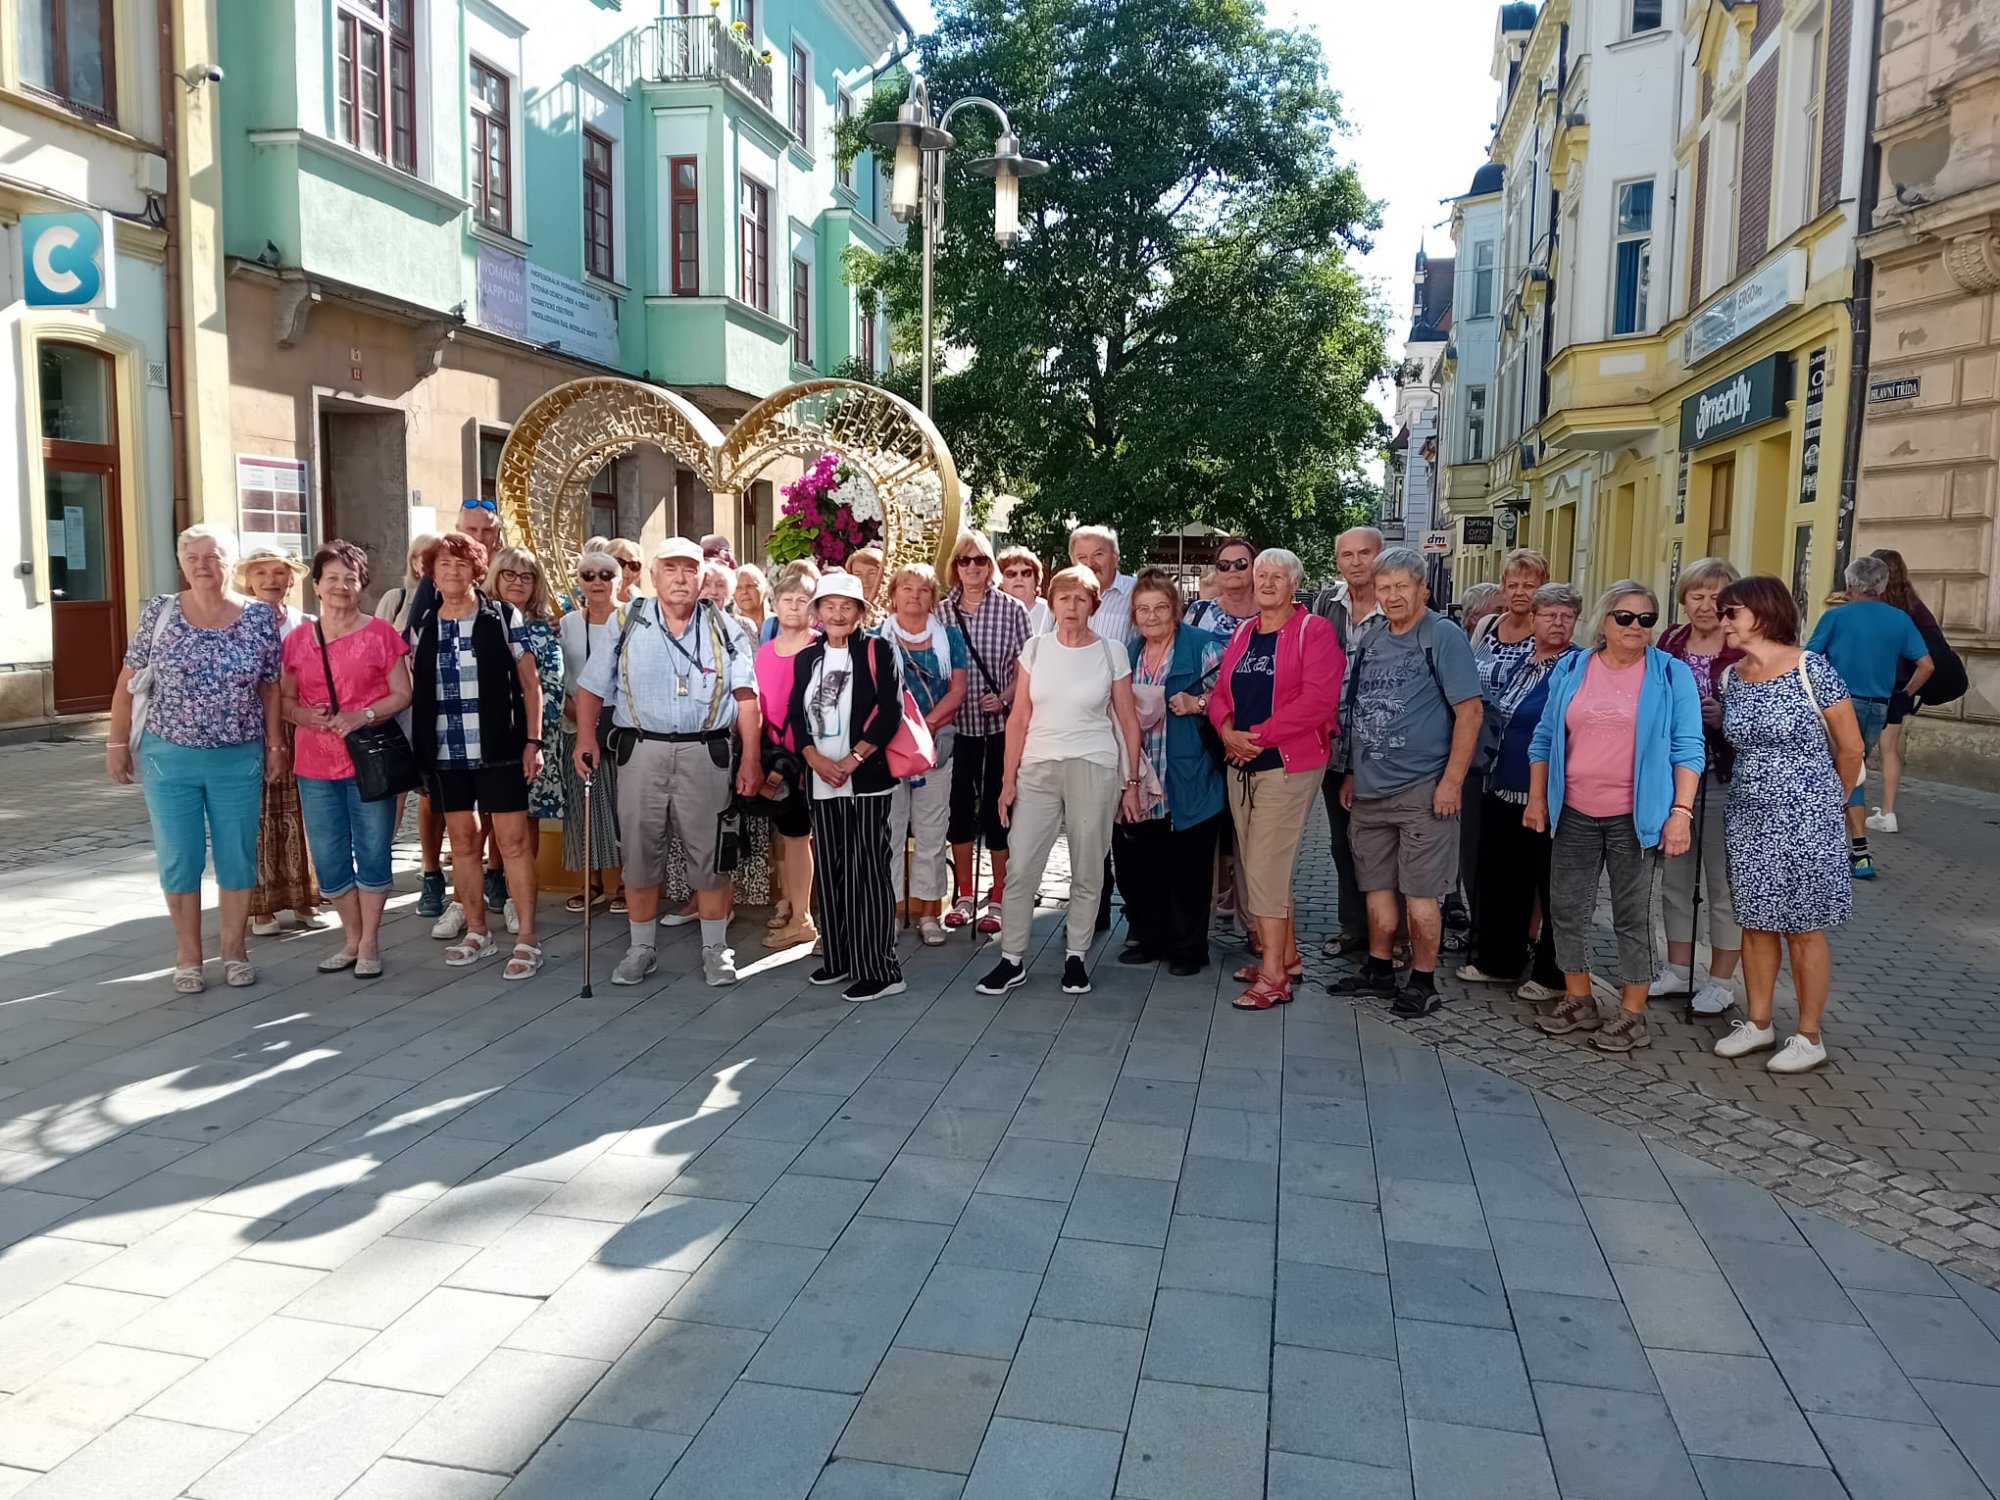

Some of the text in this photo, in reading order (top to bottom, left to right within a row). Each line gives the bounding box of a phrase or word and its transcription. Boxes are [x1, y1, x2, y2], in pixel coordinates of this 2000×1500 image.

[481, 280, 524, 305] HAPPY DAY
[1738, 284, 1755, 310] ERGO
[1870, 381, 1918, 400] HLAVNÍ TŘÍDA
[1427, 533, 1446, 544] dm
[1468, 528, 1489, 536] OPTO
